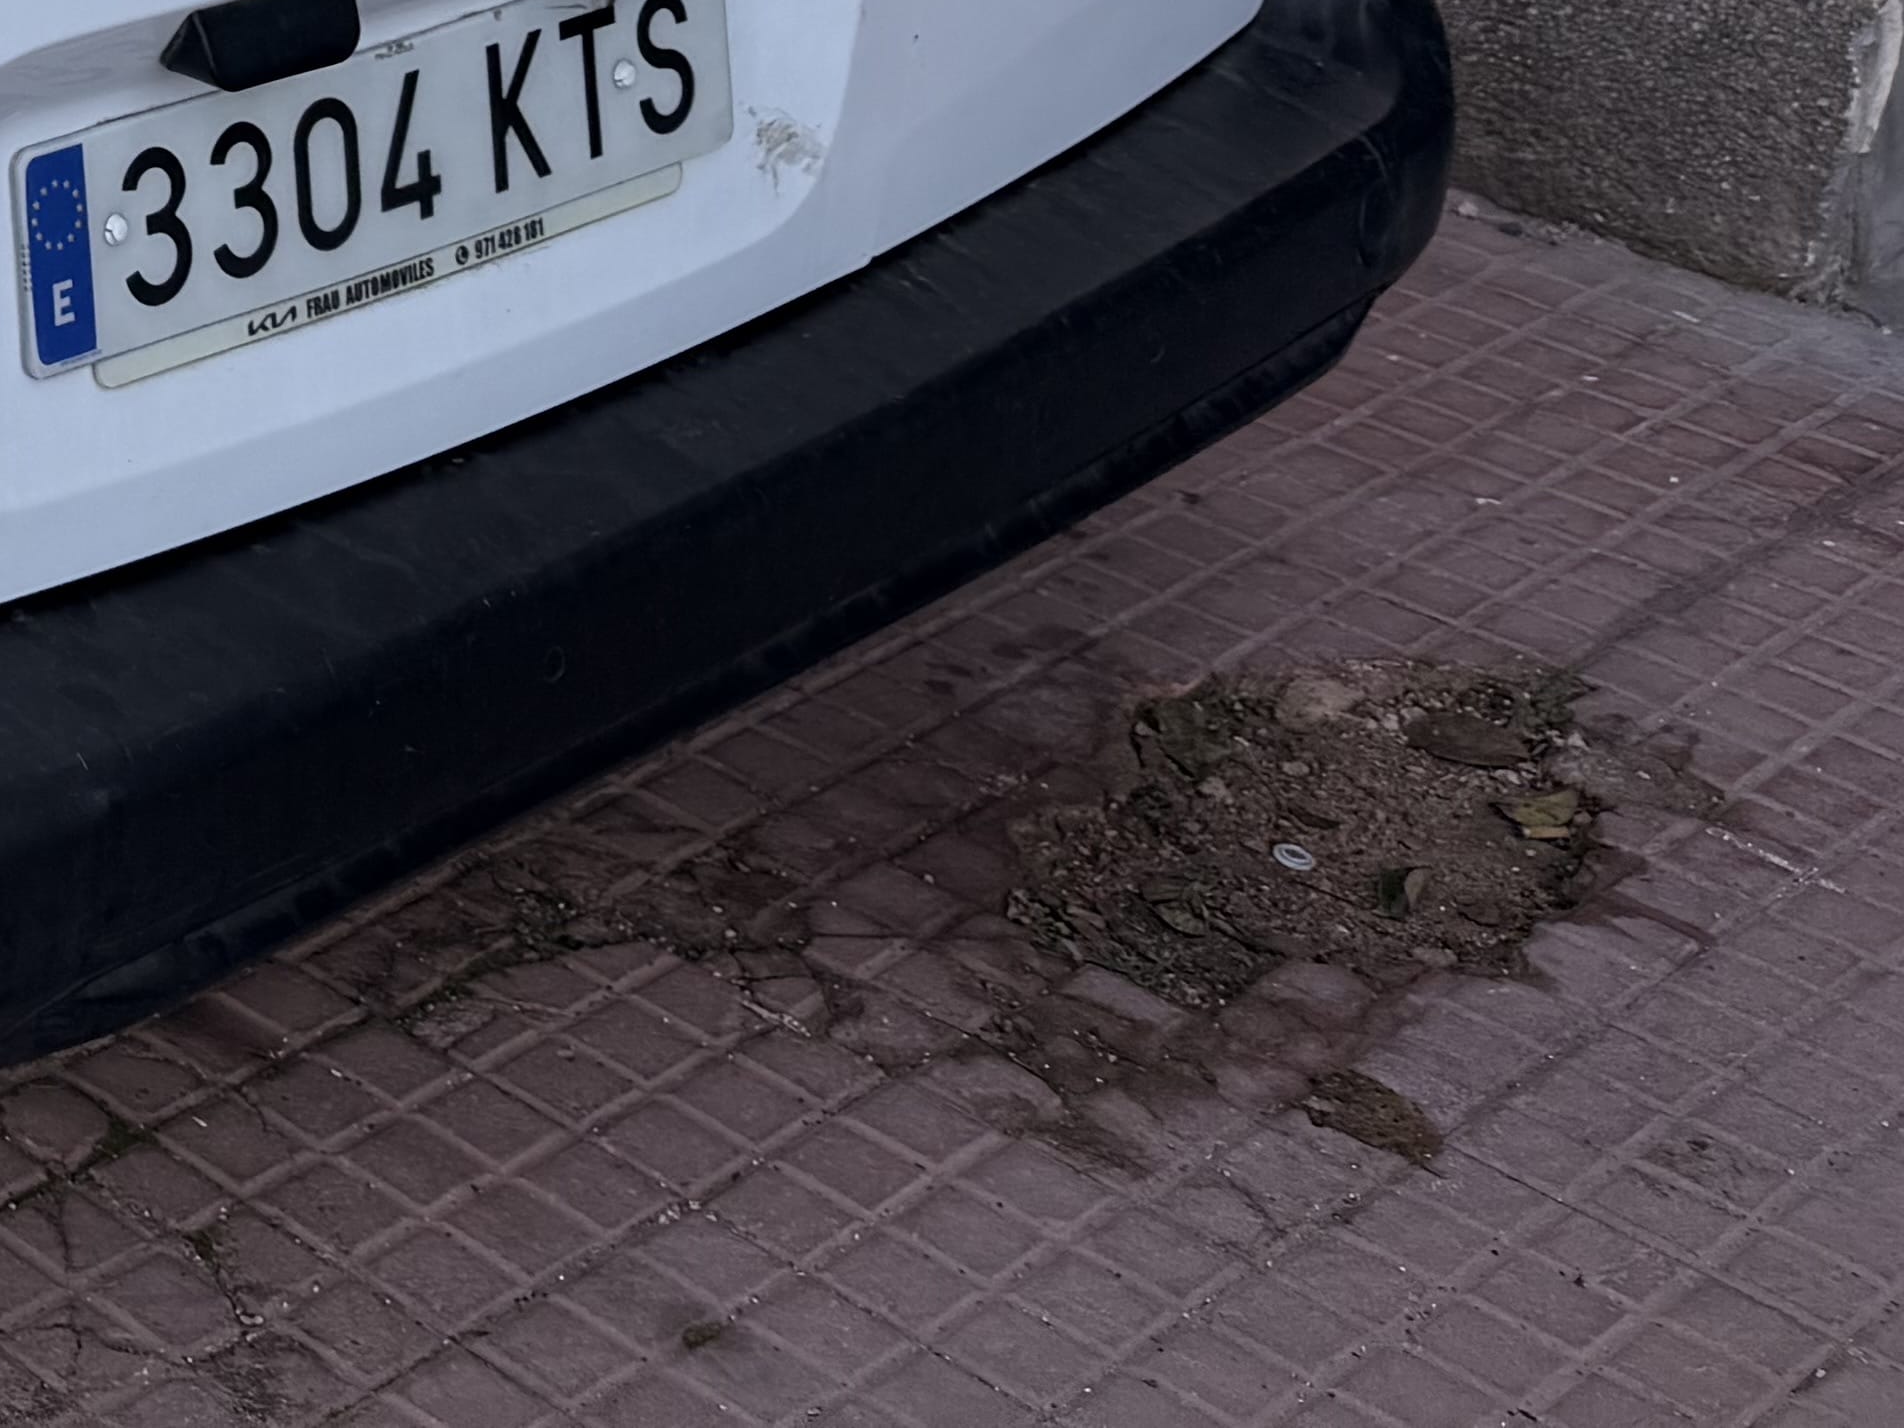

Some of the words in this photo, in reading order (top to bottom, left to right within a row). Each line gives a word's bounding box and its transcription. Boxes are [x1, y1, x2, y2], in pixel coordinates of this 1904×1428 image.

[120, 68, 443, 307] 3304
[52, 278, 76, 327] E
[306, 289, 341, 319] FRAU
[345, 257, 435, 307] AUTOMOVILES
[474, 234, 496, 259] 971
[524, 217, 544, 241] 181
